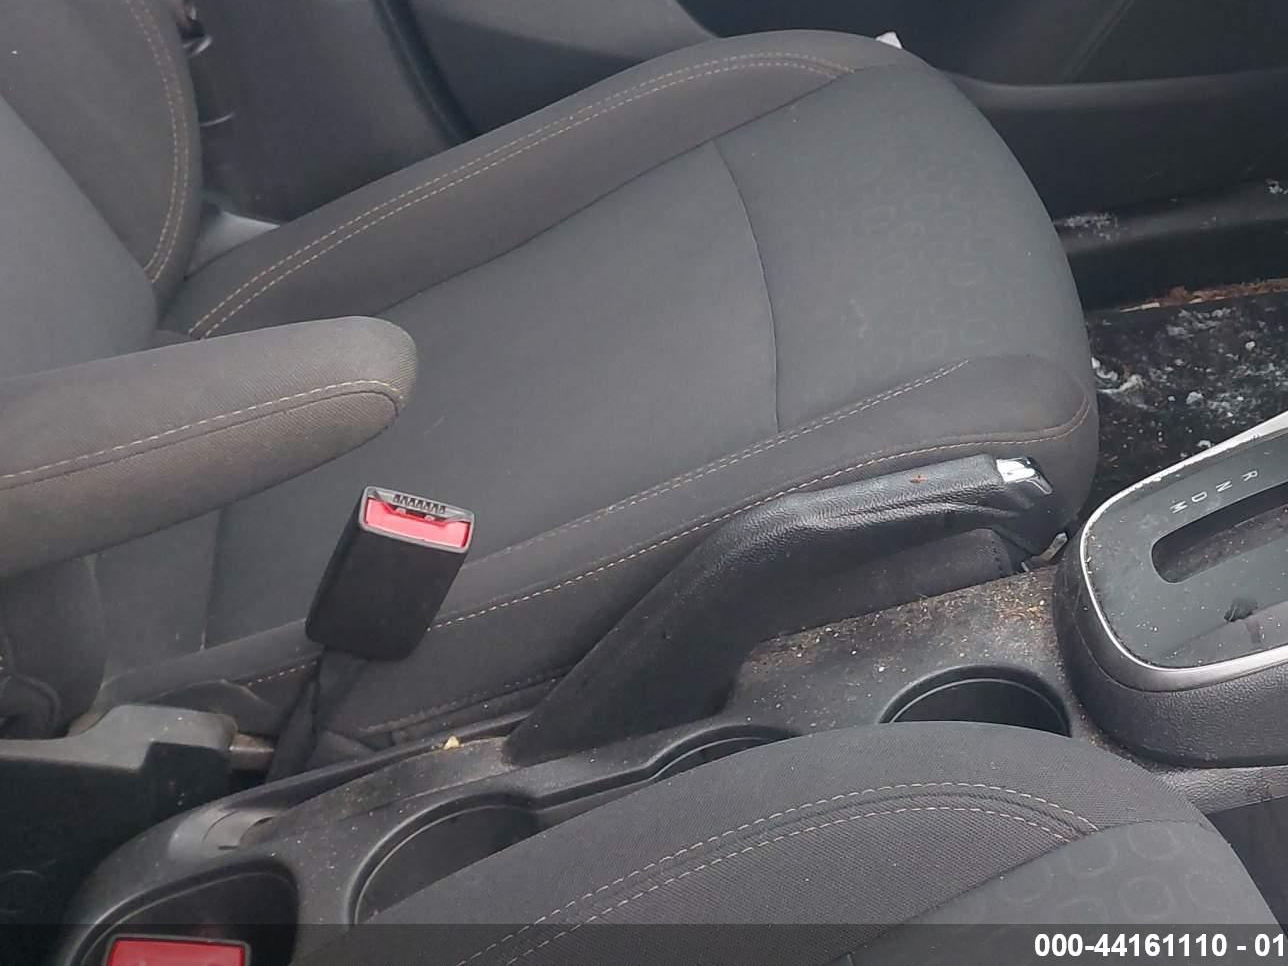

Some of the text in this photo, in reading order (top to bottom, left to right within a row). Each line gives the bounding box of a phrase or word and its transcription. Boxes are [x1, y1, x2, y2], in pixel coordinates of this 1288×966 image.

[1242, 470, 1258, 482] R
[1215, 480, 1232, 492] N
[1191, 491, 1208, 503] D
